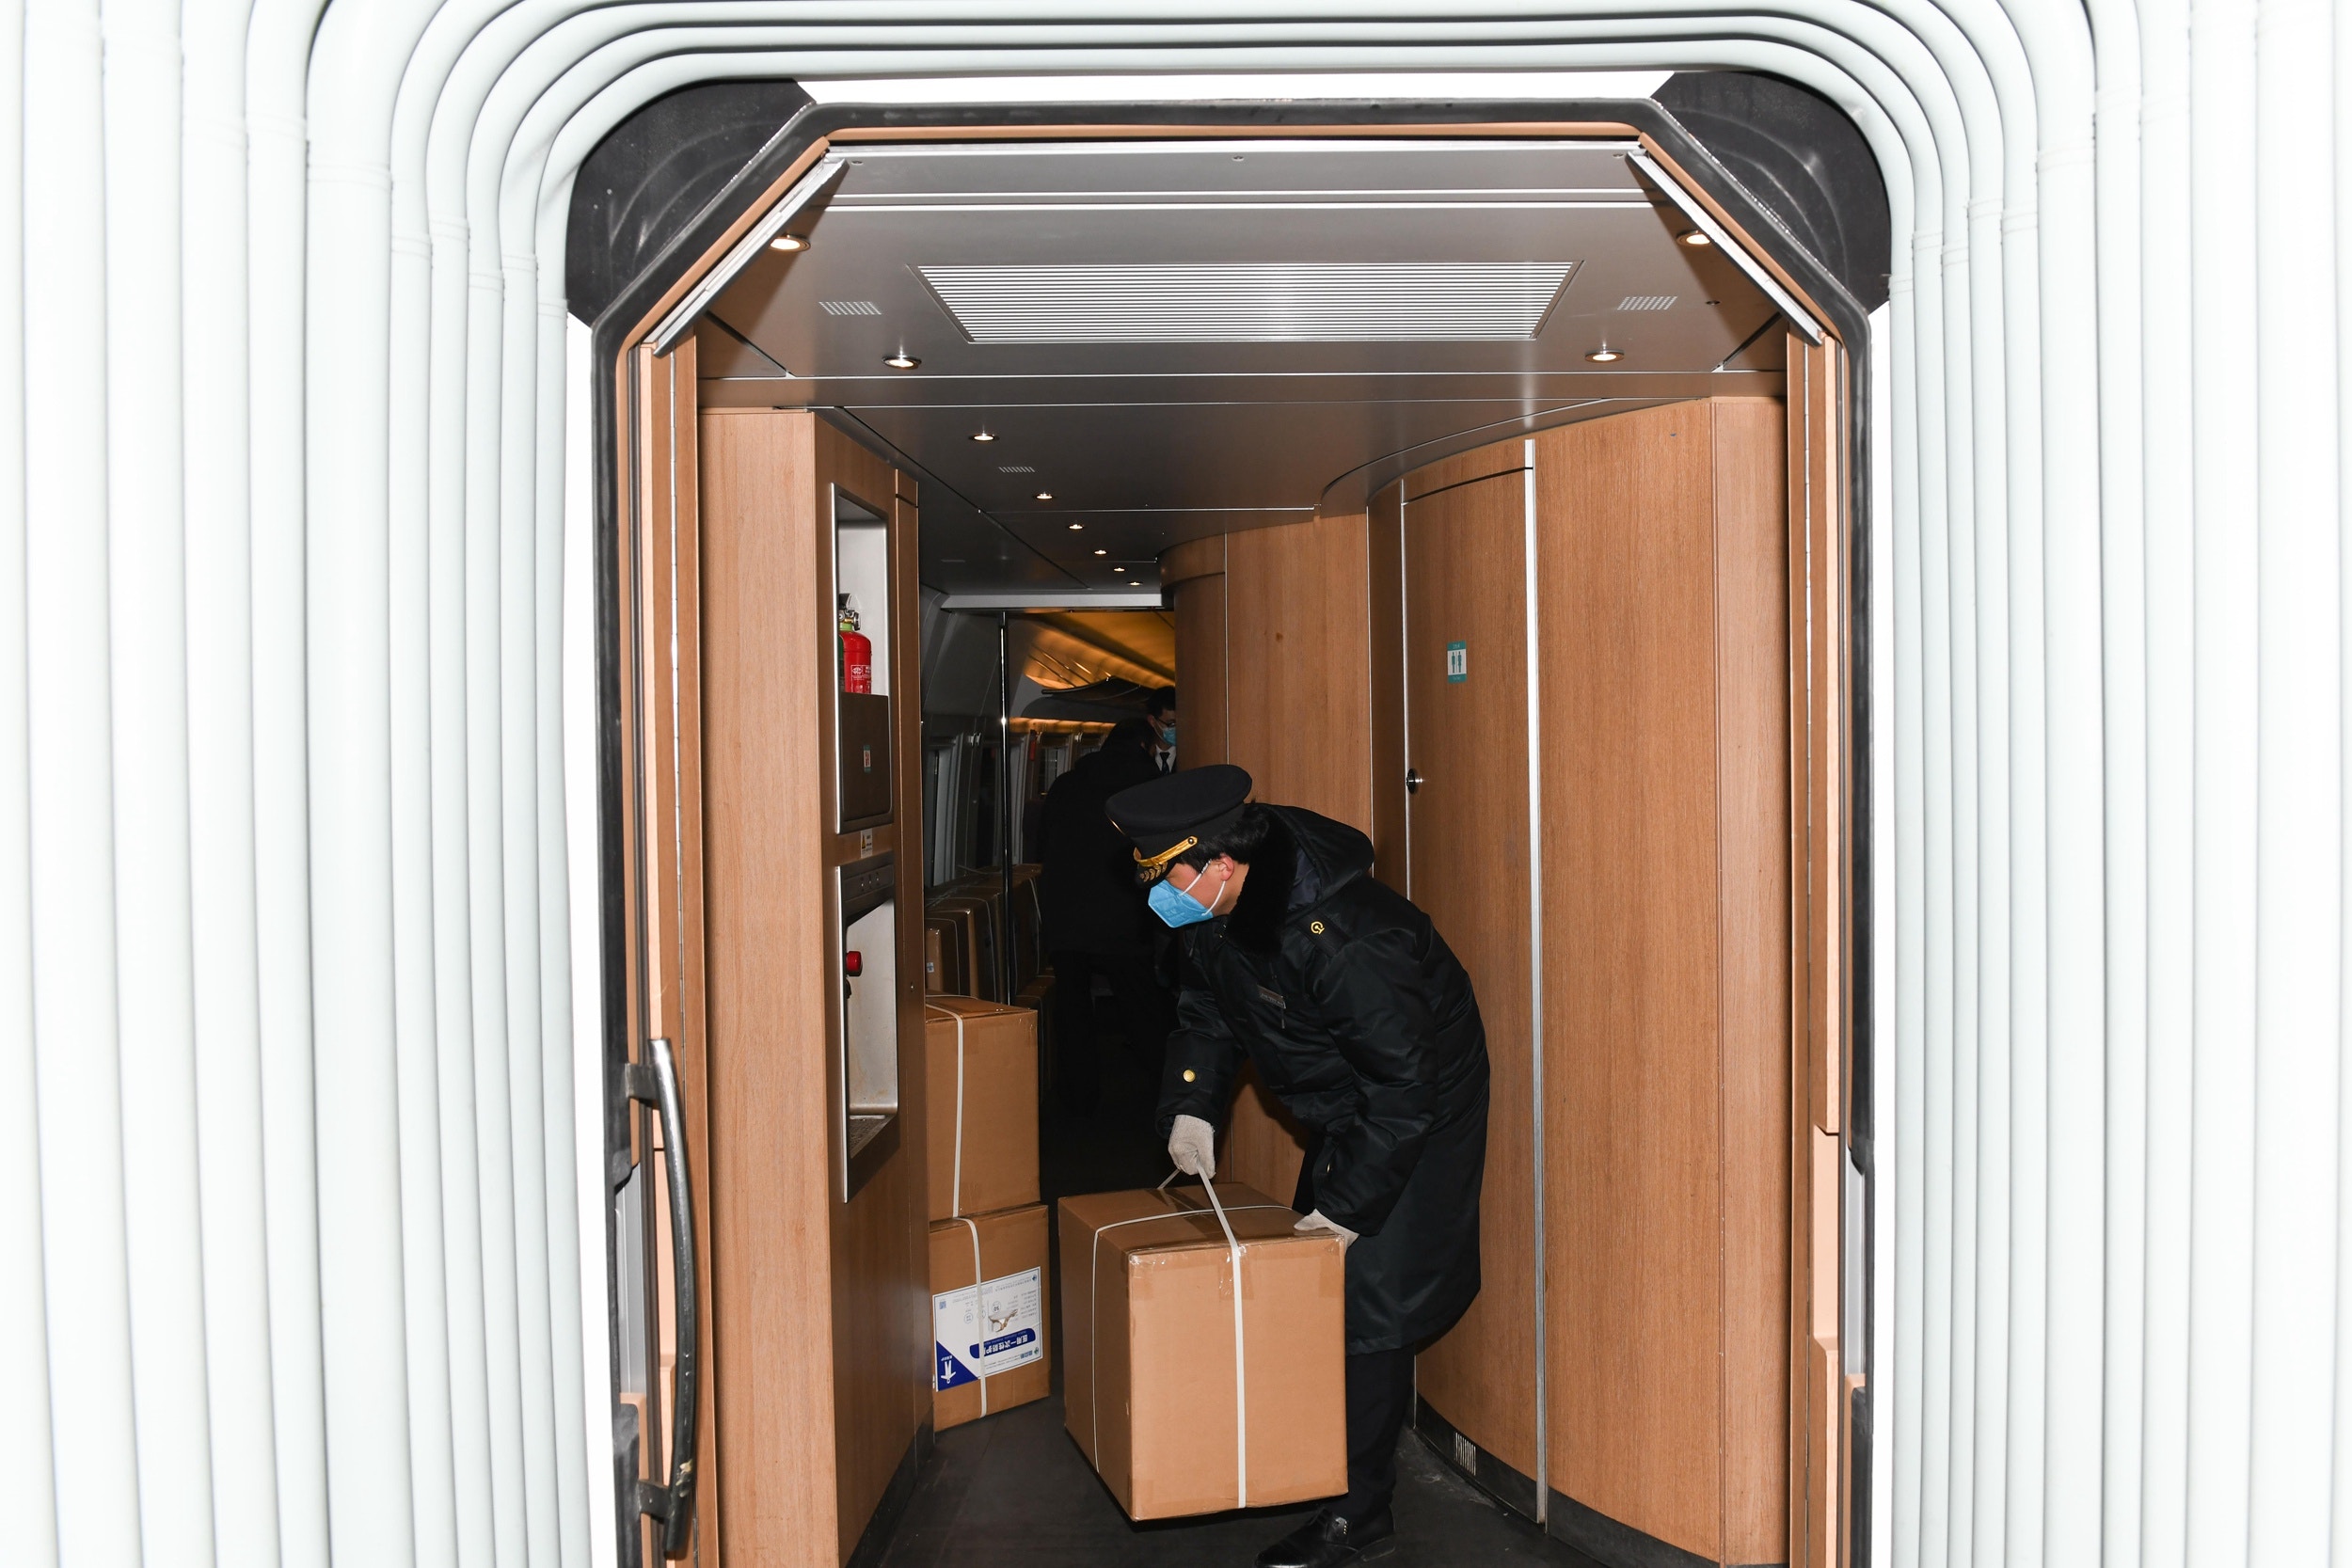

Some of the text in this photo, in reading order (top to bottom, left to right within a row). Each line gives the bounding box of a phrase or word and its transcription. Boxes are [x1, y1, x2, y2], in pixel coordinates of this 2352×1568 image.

[984, 1334, 1028, 1355] 医用一次性防护
